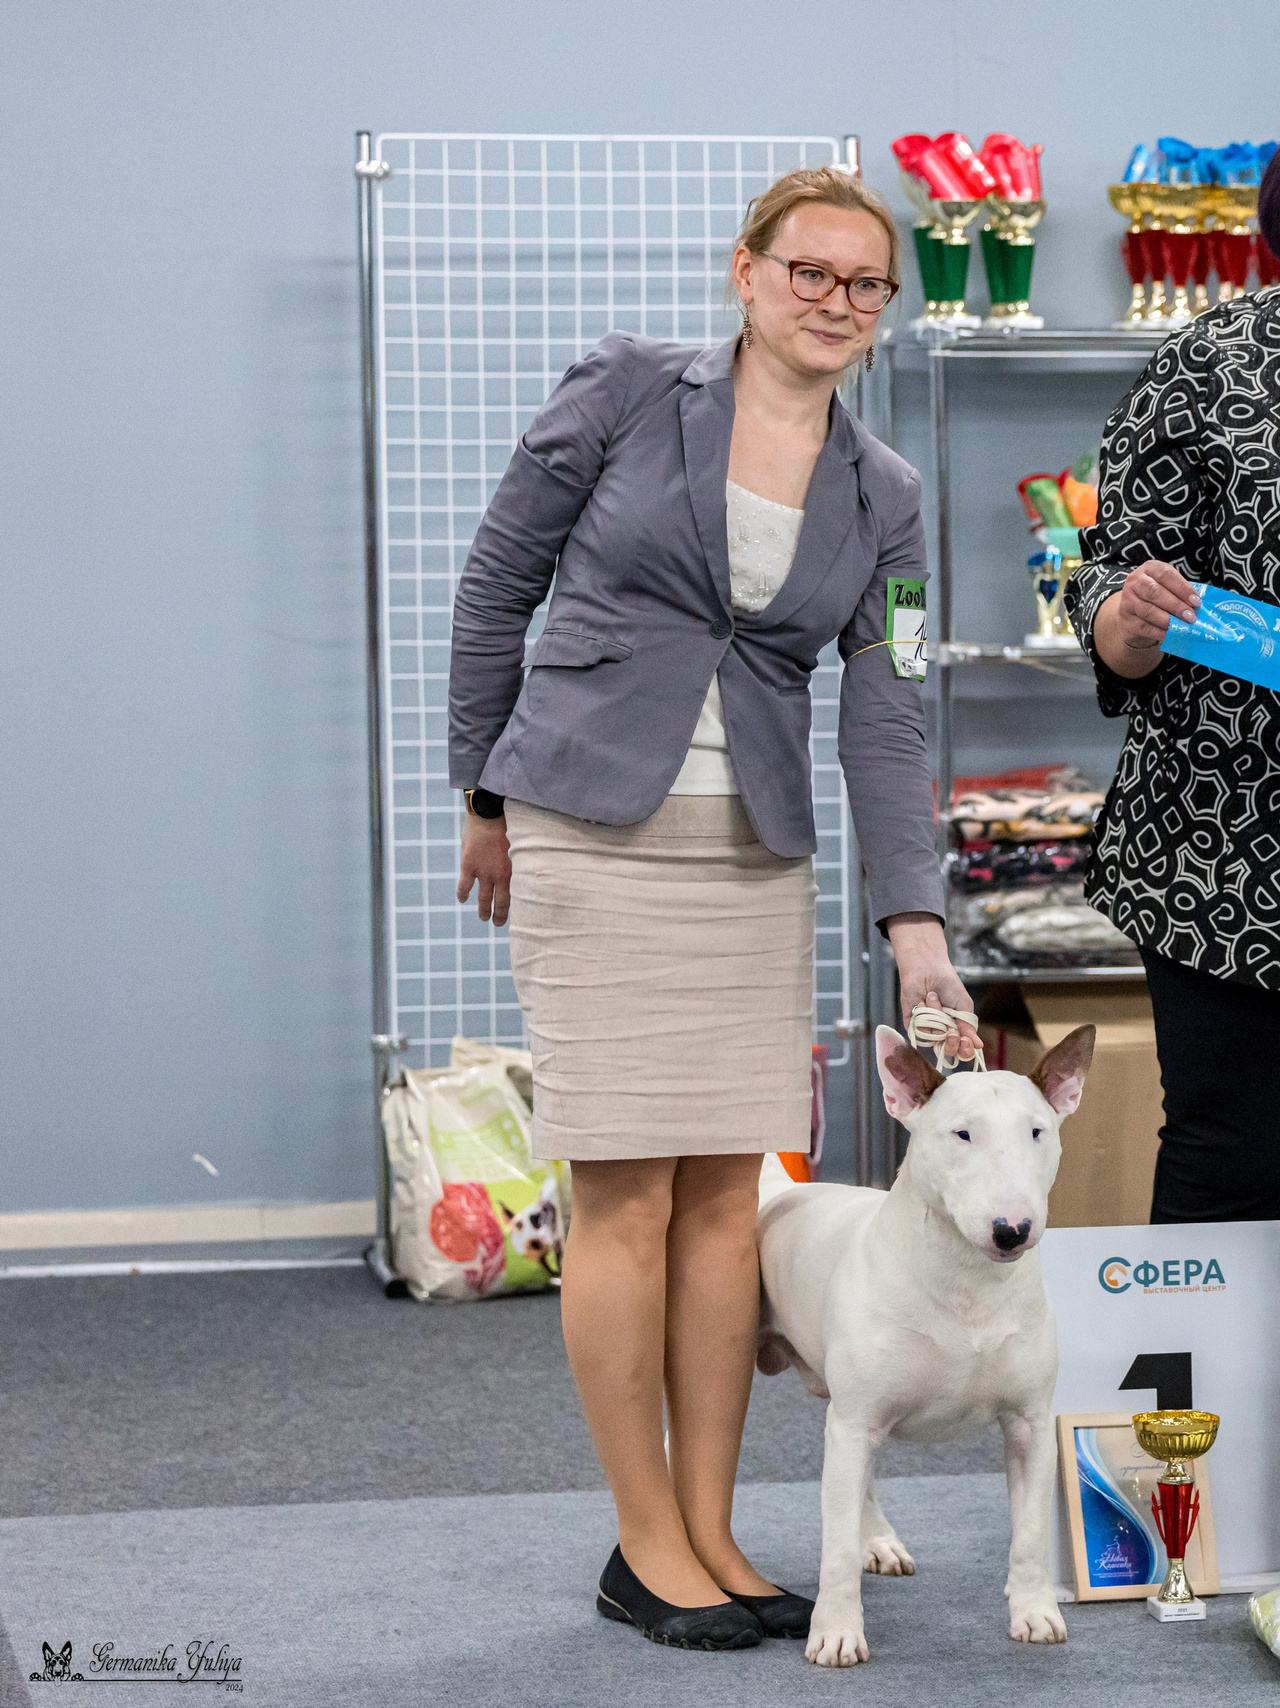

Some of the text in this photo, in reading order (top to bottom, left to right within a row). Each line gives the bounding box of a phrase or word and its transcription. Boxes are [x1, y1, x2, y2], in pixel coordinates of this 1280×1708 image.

[1098, 1256, 1226, 1294] СФЕРА
[1143, 1285, 1227, 1295] ВЫСТАВОЧНЫЙ ЦЕНТР
[1117, 1351, 1193, 1411] 1
